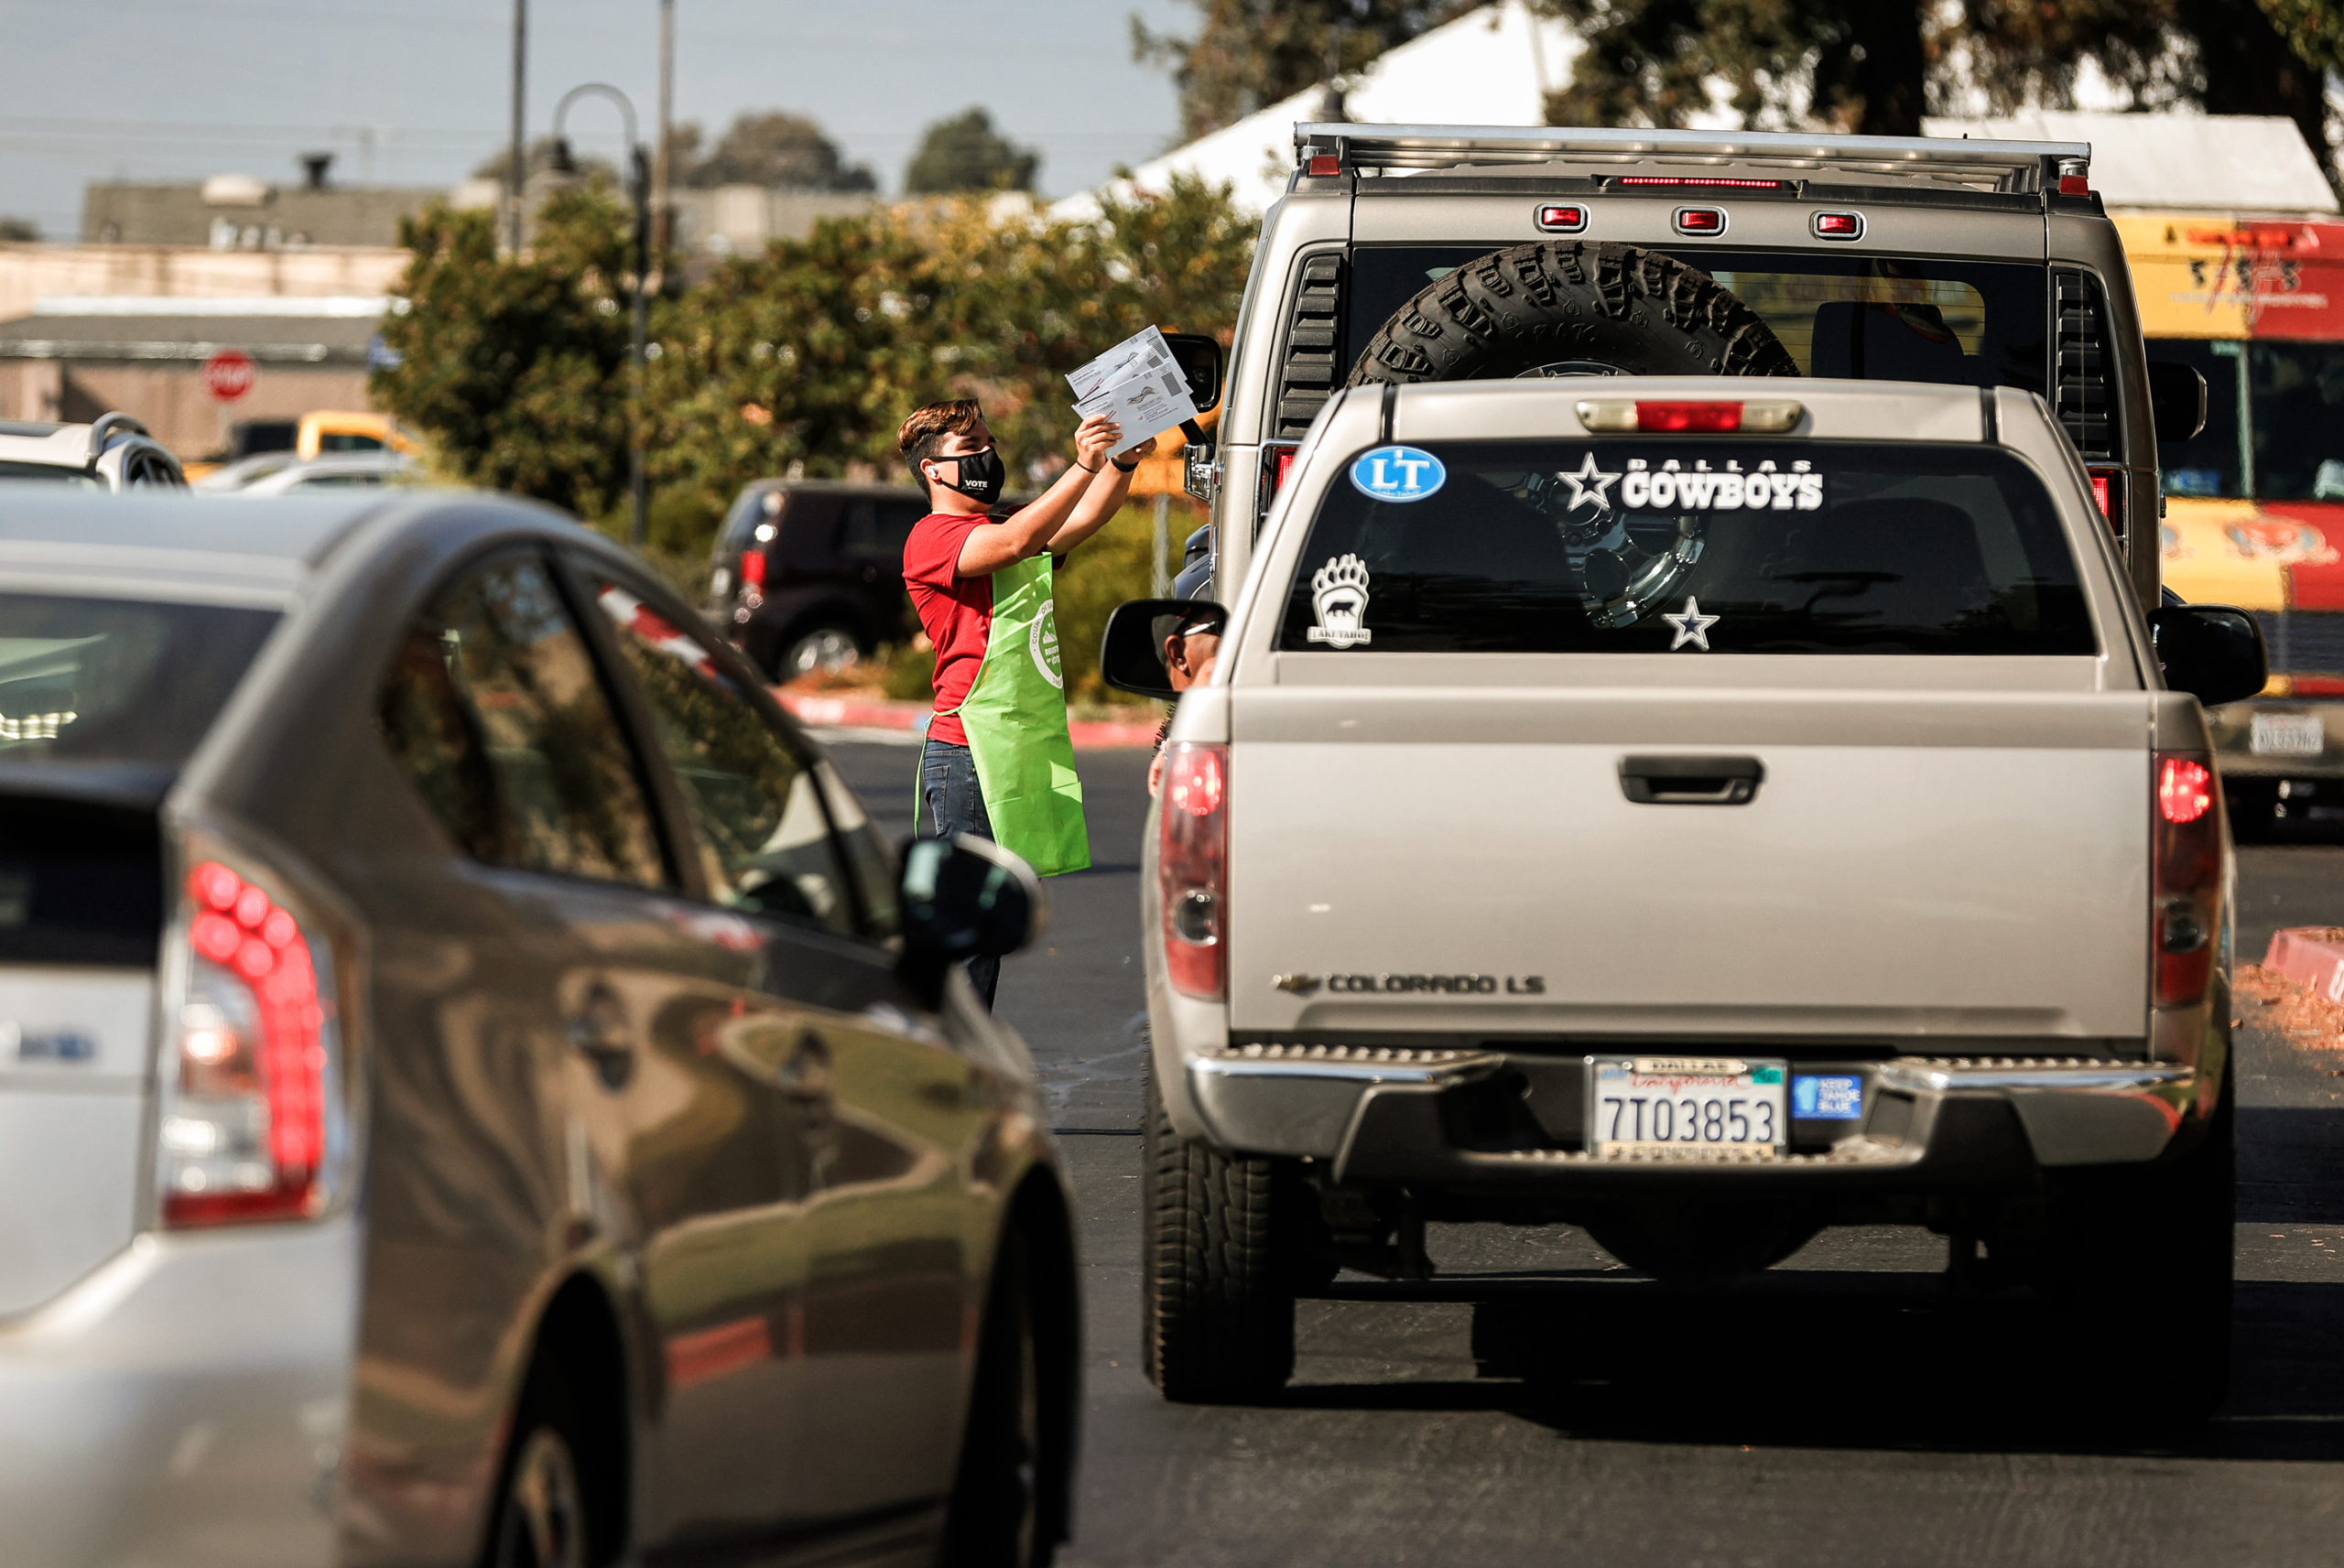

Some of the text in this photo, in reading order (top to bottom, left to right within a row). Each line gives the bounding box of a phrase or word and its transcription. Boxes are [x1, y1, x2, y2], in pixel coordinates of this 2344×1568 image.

[1371, 458, 1430, 491] LT
[1627, 459, 1812, 472] DALLAS
[965, 479, 988, 488] VOTE
[1621, 471, 1823, 510] COWBOYS
[1340, 630, 1370, 640] TAHOE
[1329, 975, 1546, 994] COLORADO LS
[1603, 1098, 1774, 1142] 7T03853
